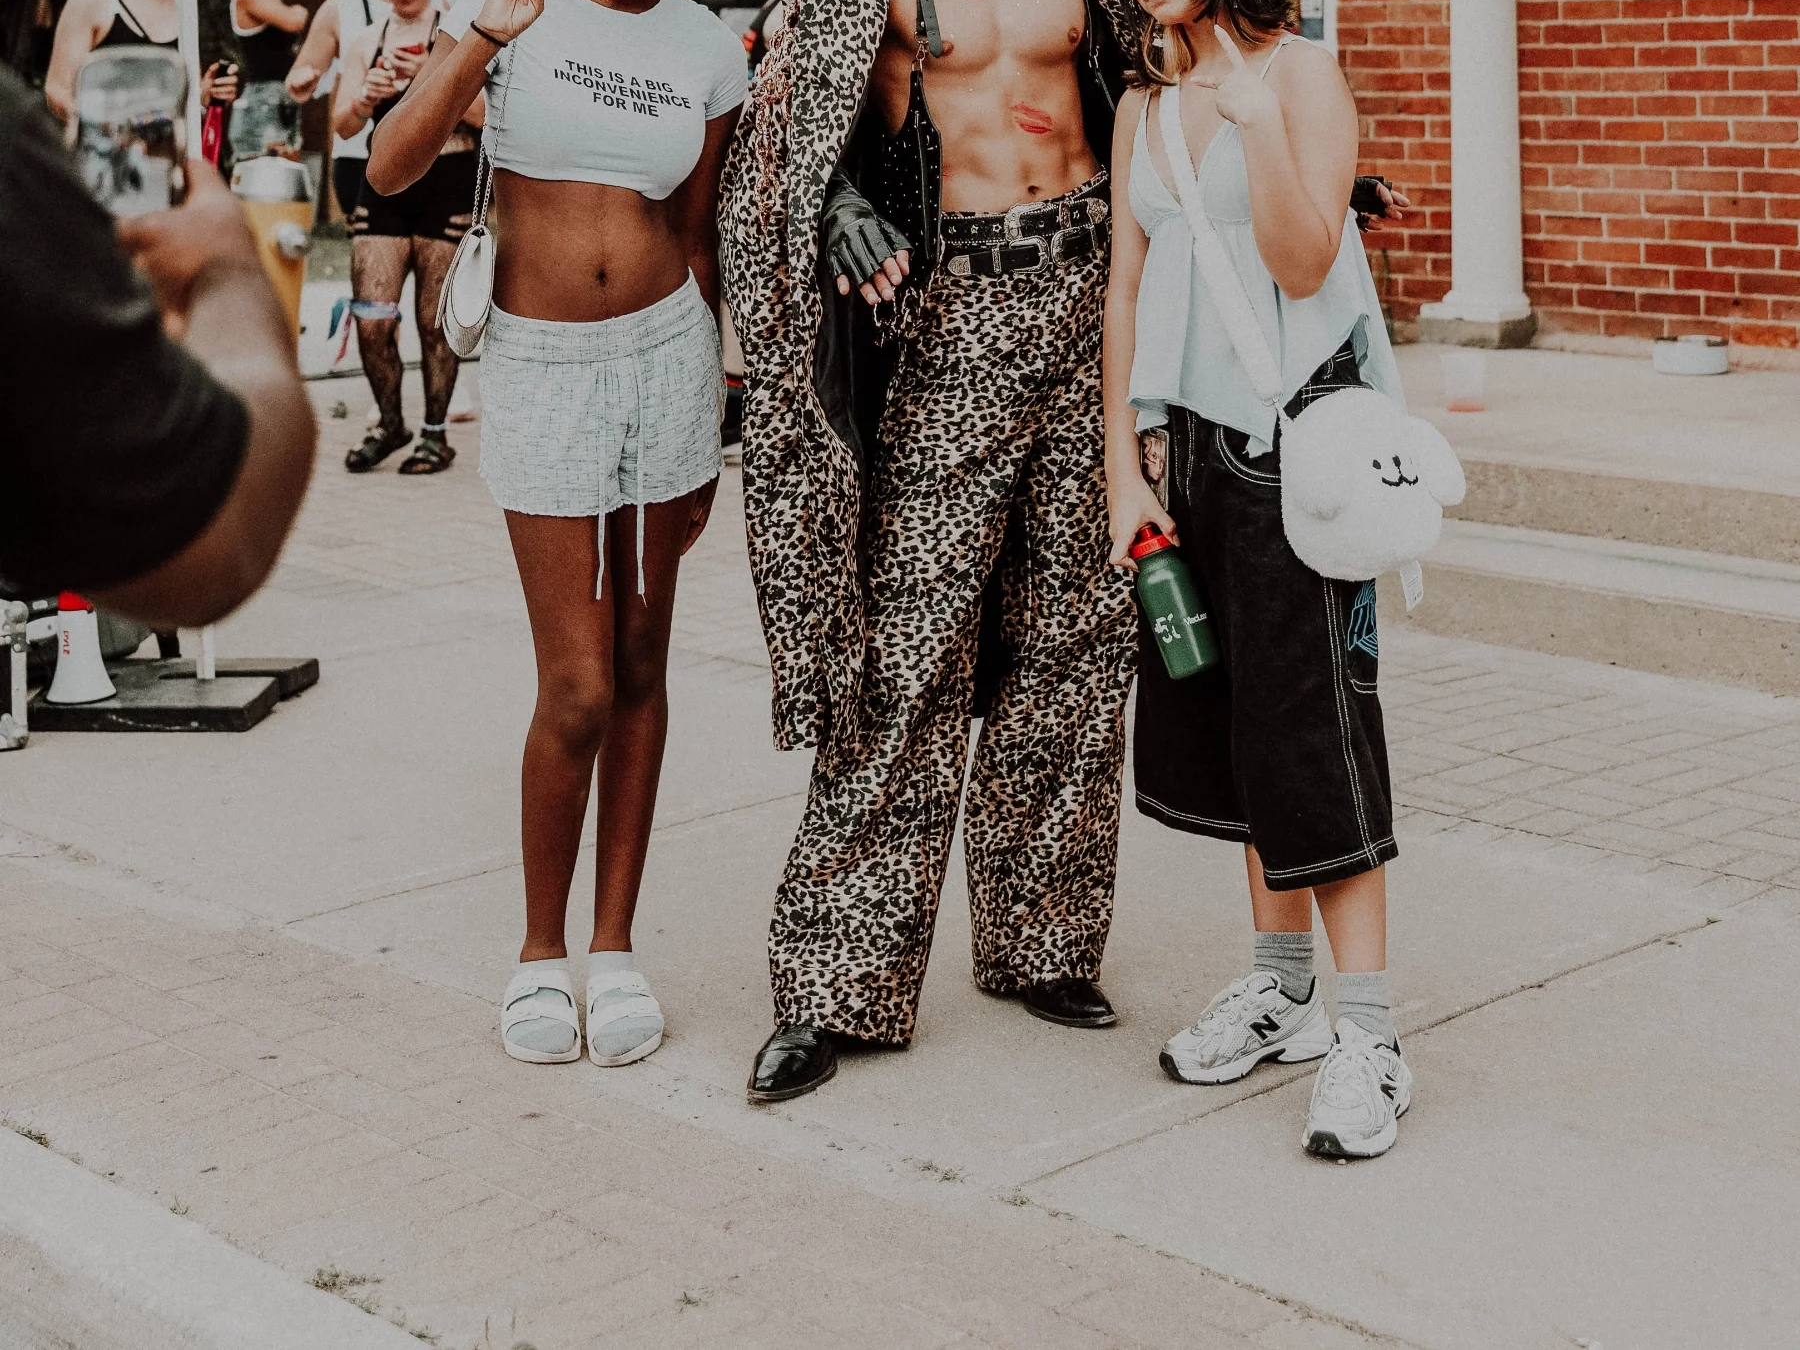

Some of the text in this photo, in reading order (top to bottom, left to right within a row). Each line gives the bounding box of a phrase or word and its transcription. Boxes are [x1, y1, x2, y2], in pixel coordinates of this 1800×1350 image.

[554, 68, 692, 110] INCONVENIENCE
[565, 59, 674, 93] THIS IS A BIG
[593, 91, 660, 118] FOR ME
[1249, 1012, 1282, 1041] N
